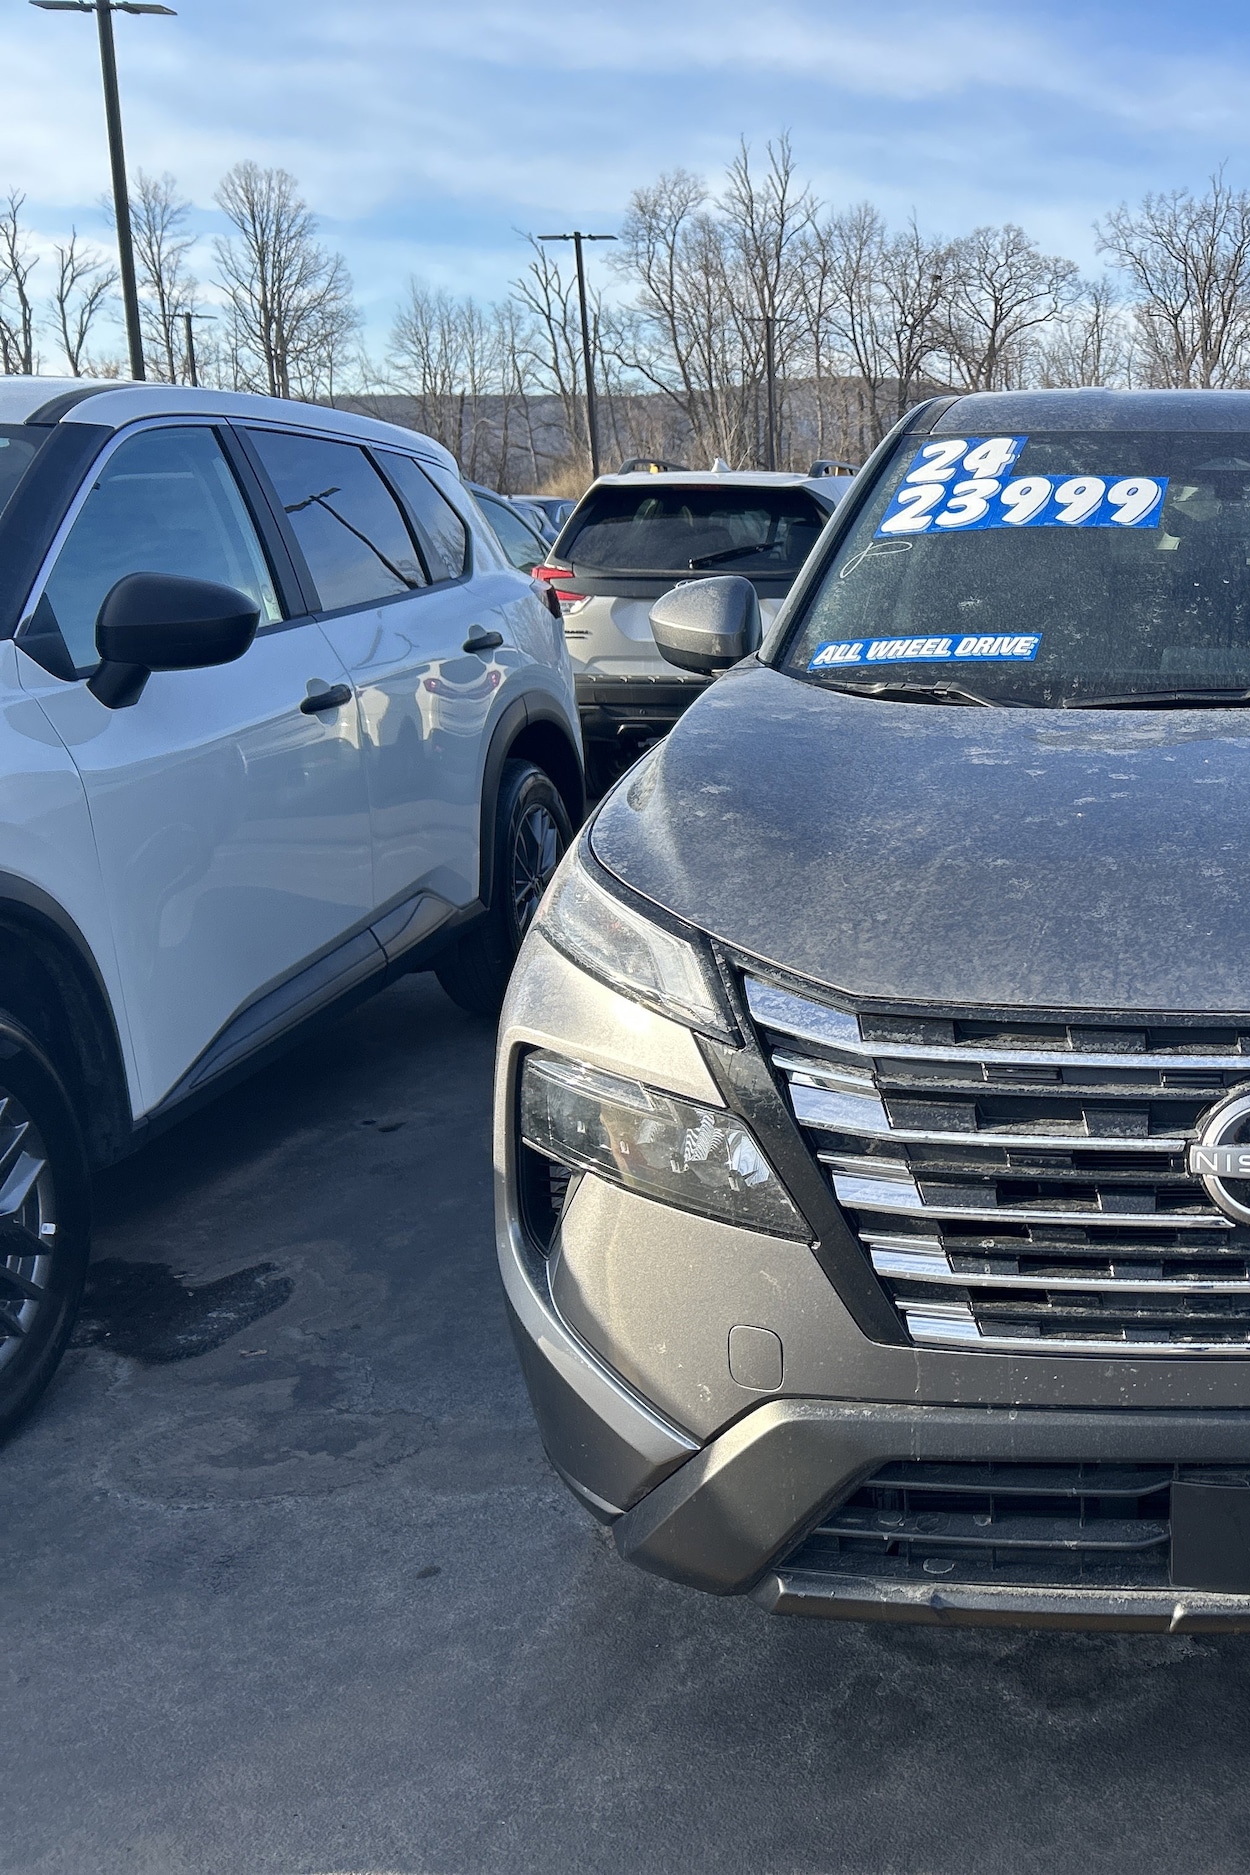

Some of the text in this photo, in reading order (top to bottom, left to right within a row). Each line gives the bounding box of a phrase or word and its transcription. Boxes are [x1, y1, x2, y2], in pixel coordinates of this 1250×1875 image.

[906, 437, 1018, 484] 24
[881, 476, 1162, 535] 23999
[812, 635, 1039, 666] ALL WHEEL DRIVE
